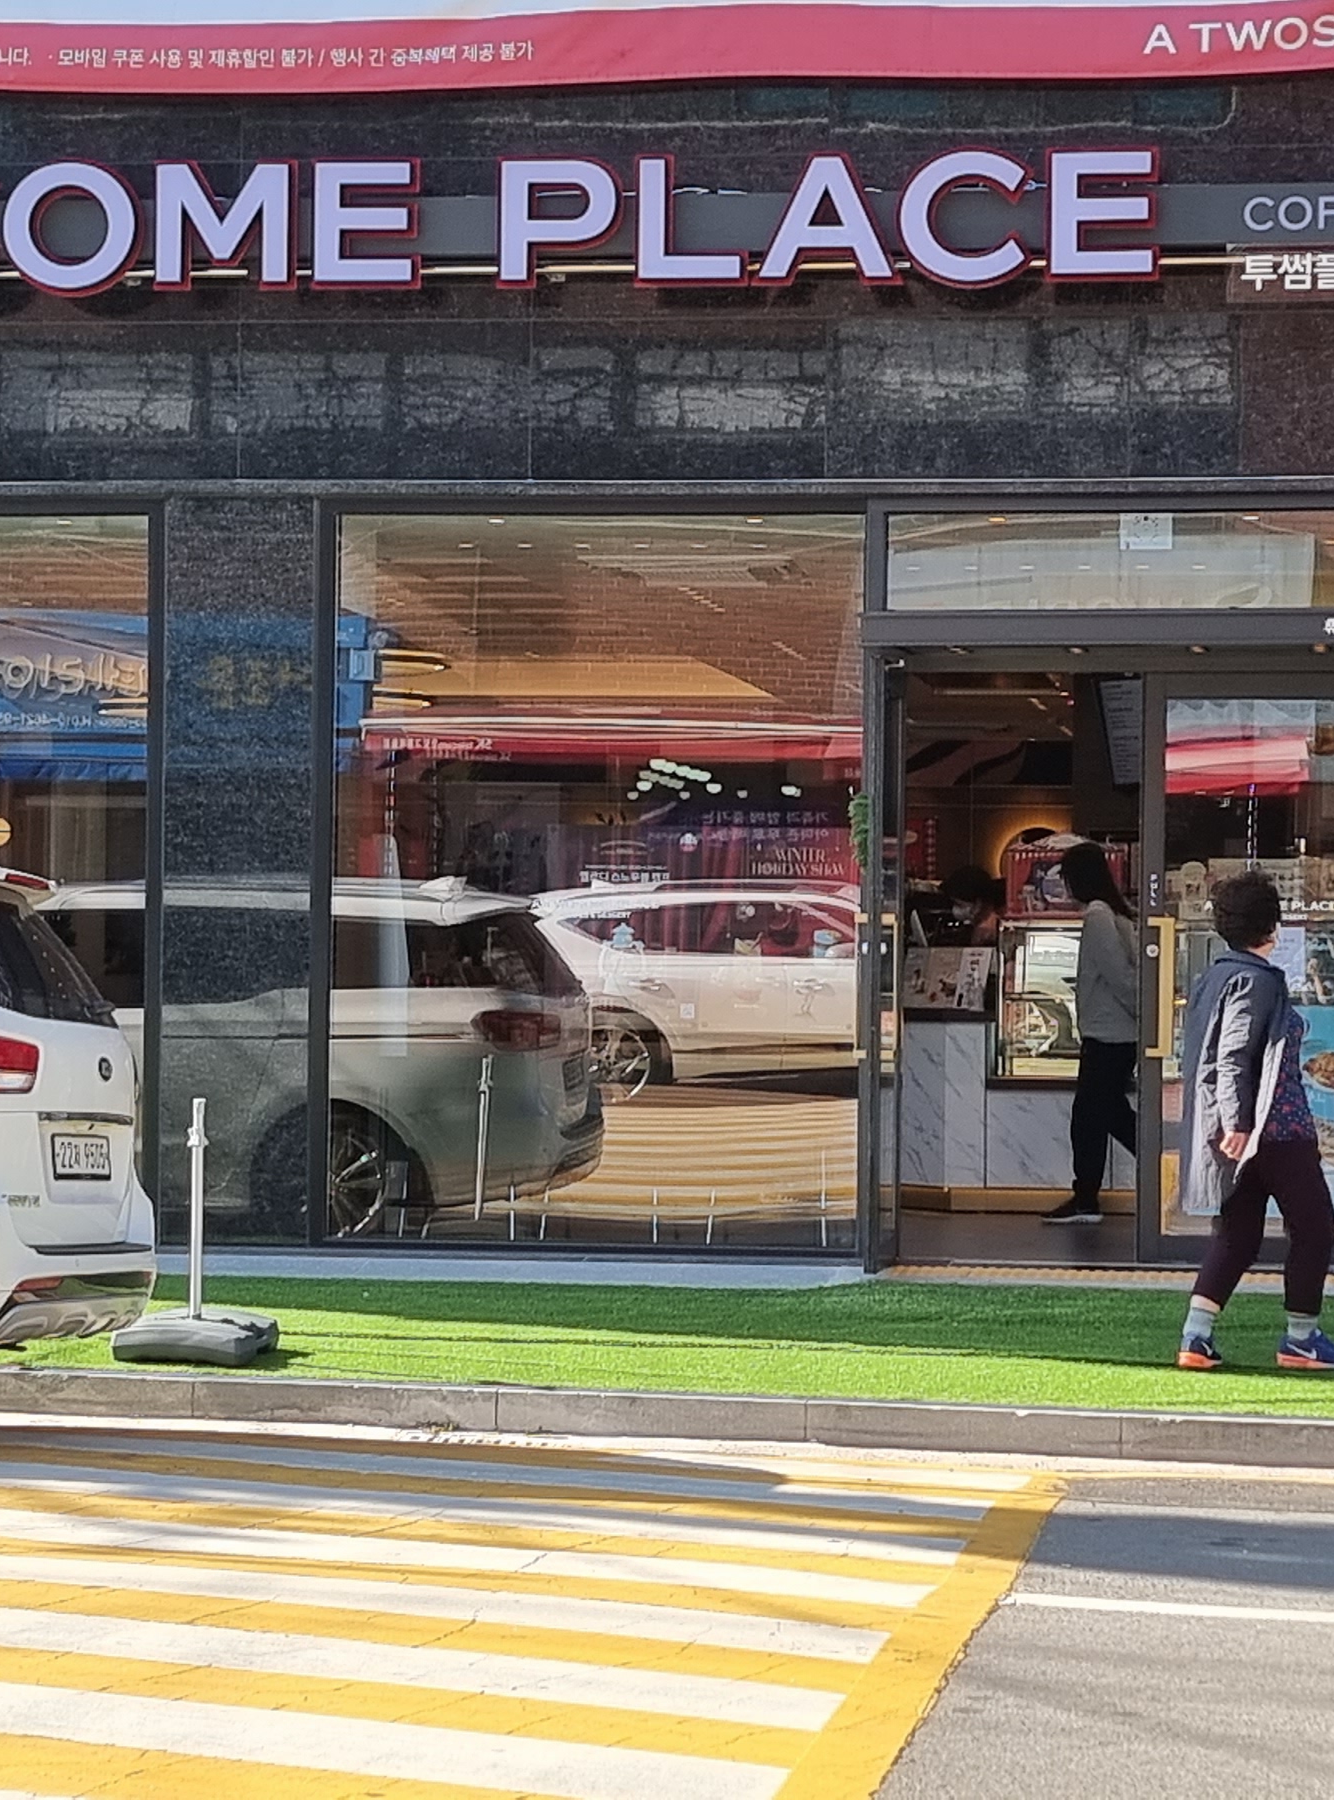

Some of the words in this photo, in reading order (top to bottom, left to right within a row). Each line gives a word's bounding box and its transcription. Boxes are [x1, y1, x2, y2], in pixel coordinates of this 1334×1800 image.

[57, 47, 108, 69] 모바일
[111, 48, 146, 69] 쿠폰
[149, 48, 184, 69] 사용
[187, 48, 204, 70] 및
[207, 48, 276, 69] 제휴할인
[280, 47, 315, 68] 불가
[329, 47, 365, 68] 행사
[368, 47, 387, 68] 간
[390, 44, 457, 67] 중복혜택
[461, 42, 496, 62] 제공
[499, 39, 535, 62] 불가
[1143, 22, 1178, 56] A
[497, 147, 1161, 289] PLACE
